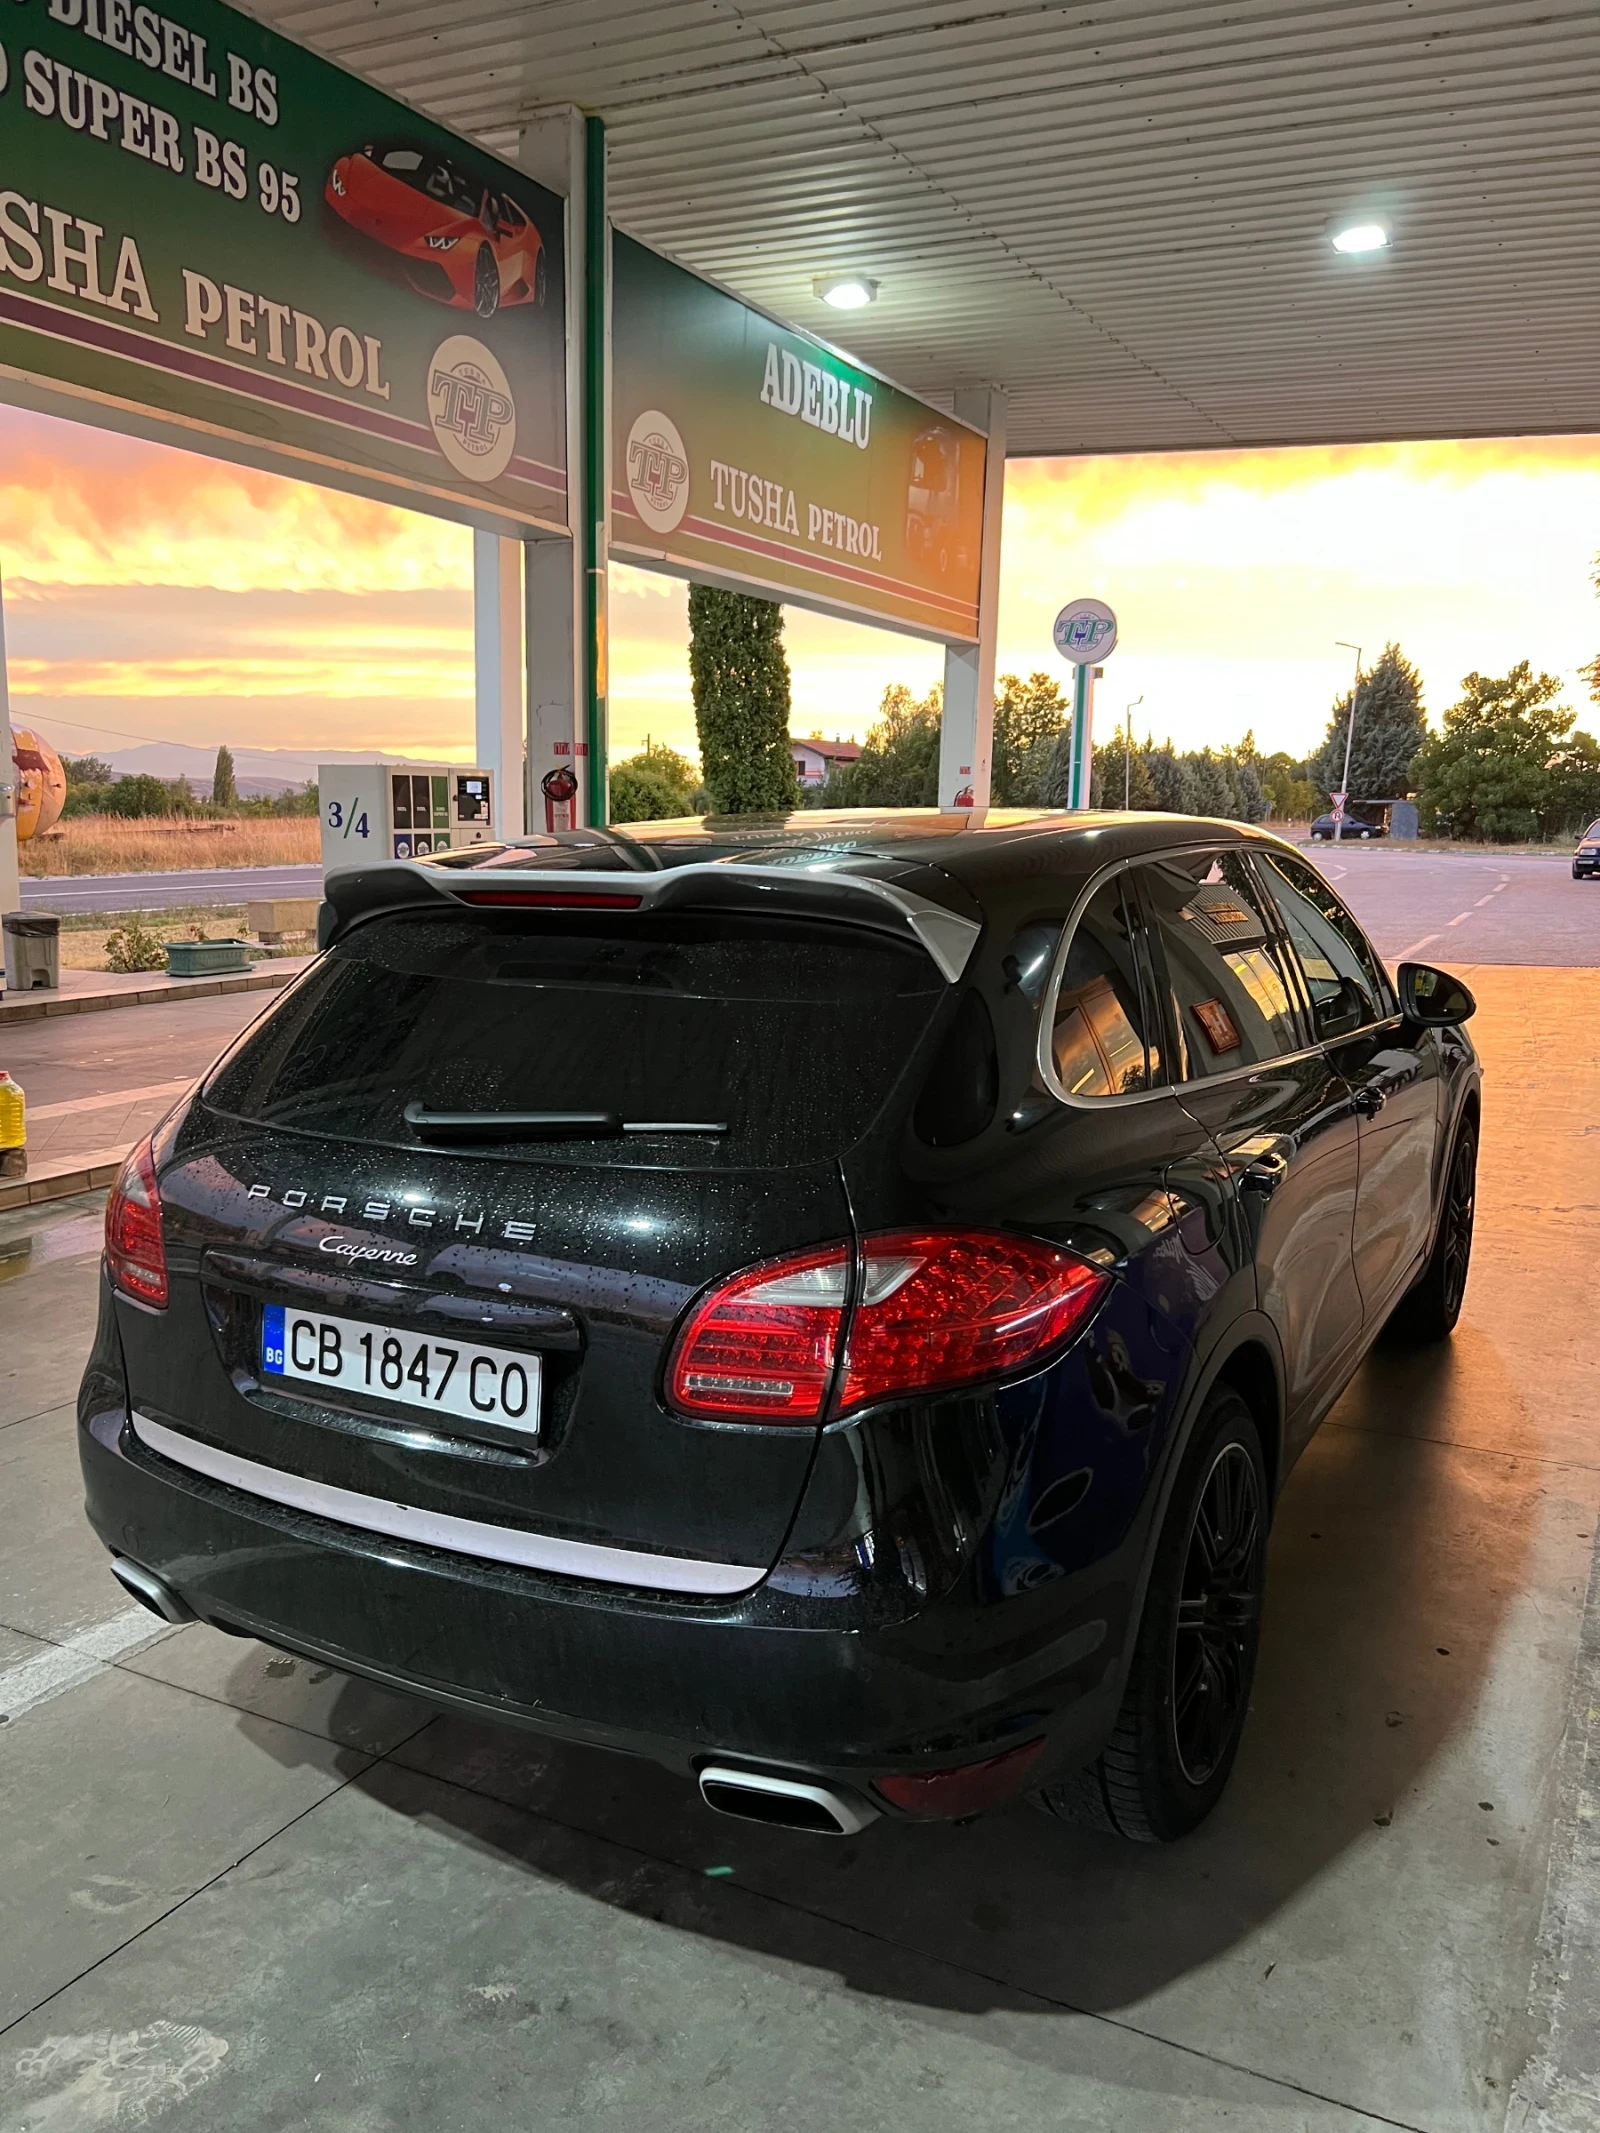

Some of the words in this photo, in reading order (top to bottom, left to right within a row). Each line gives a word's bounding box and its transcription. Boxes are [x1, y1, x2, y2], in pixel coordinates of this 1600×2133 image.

[226, 51, 279, 126] BS
[23, 49, 184, 173] SUPER
[193, 126, 248, 200] BS
[258, 162, 300, 223] 95
[181, 267, 391, 400] PETROL
[760, 342, 873, 450] ADEBLU
[710, 459, 800, 537] TUSHA
[807, 503, 882, 562] PETROL
[328, 797, 370, 839] 3/4
[247, 1184, 537, 1242] PORSCHE
[318, 1235, 418, 1268] Cayenne
[266, 1346, 284, 1366] BG
[291, 1319, 343, 1378] CB
[359, 1332, 460, 1402] 1847
